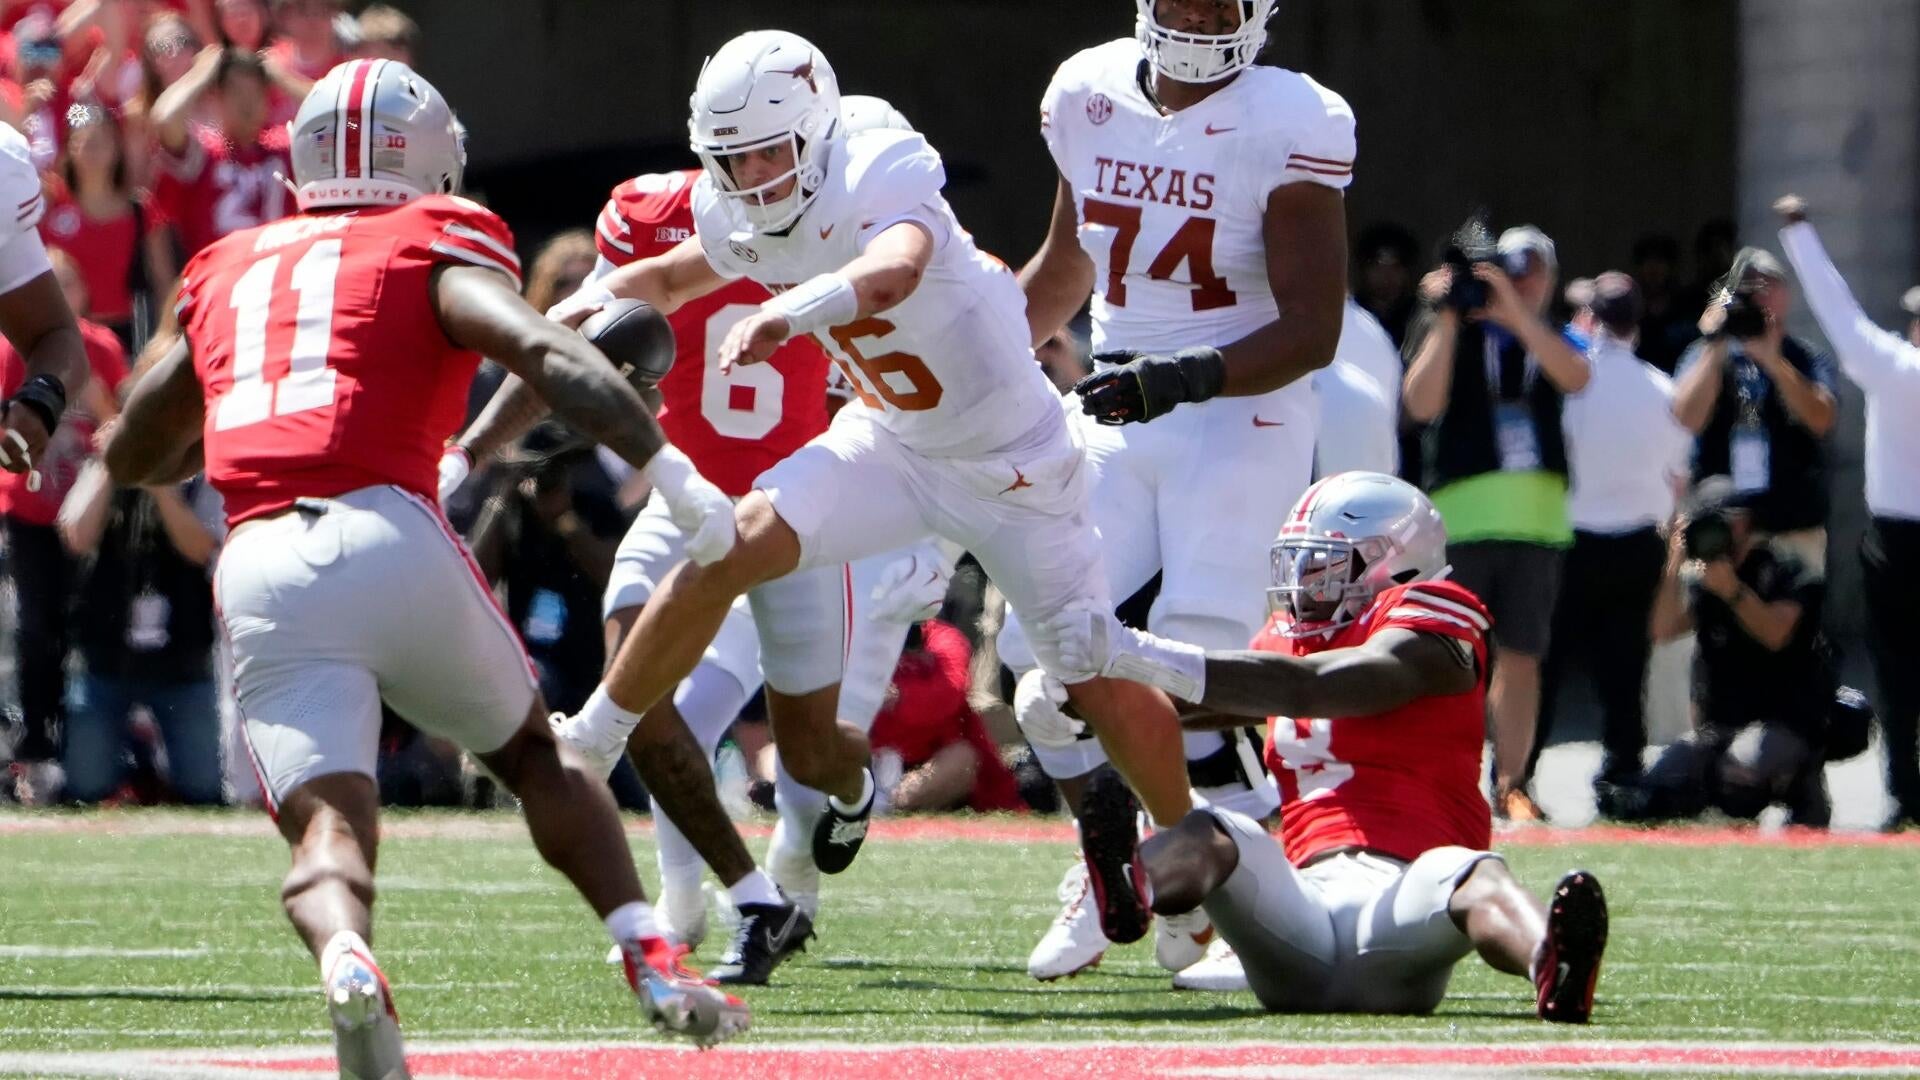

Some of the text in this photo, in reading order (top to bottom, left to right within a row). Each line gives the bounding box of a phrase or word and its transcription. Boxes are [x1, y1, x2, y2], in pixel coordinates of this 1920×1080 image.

[1095, 157, 1215, 210] TEXAS
[1083, 197, 1237, 312] 74
[215, 238, 343, 432] 11
[701, 302, 785, 440] 6
[1273, 715, 1355, 802] 8
